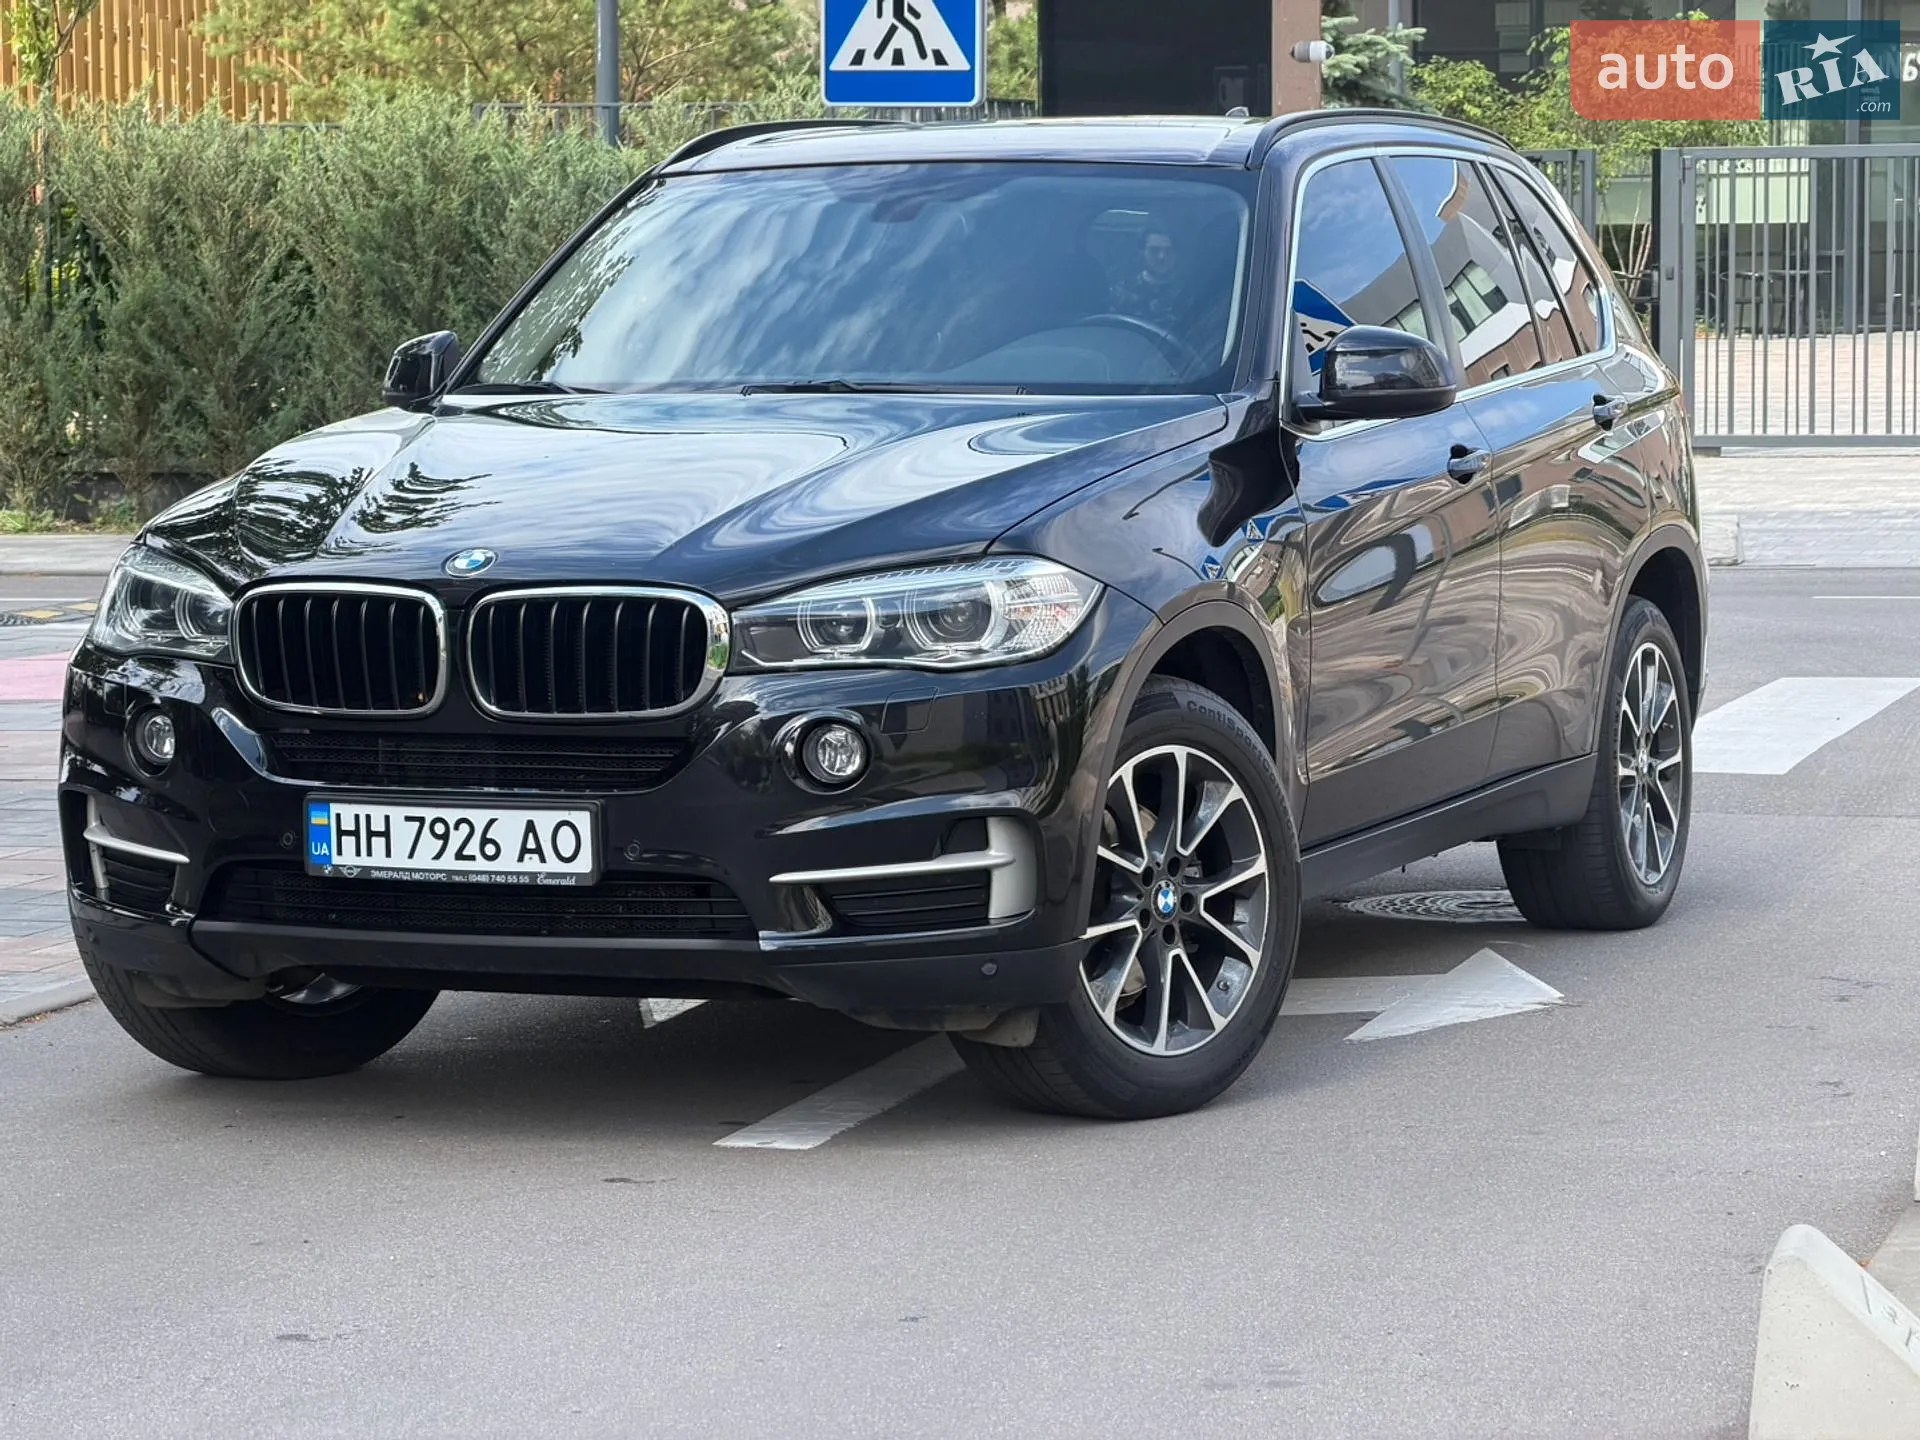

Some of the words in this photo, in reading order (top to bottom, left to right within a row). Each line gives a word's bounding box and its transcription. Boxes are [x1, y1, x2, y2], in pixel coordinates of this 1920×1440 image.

[311, 841, 330, 856] UA
[335, 812, 392, 858] HH
[403, 815, 502, 862] 7926
[516, 819, 582, 864] AO
